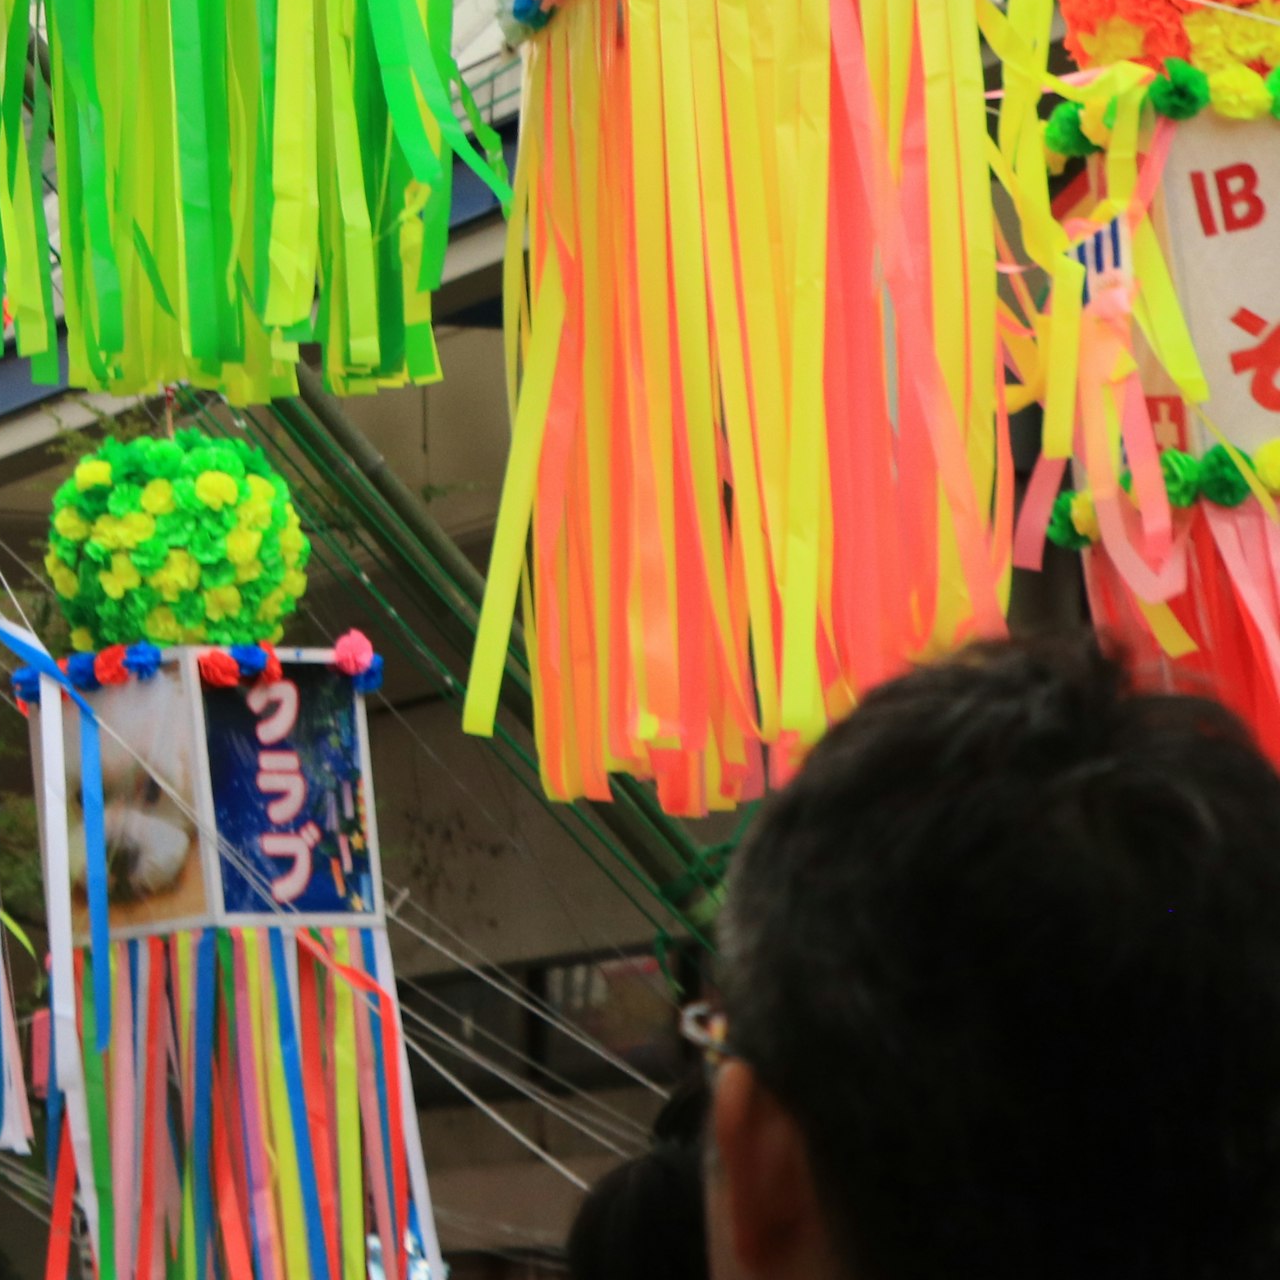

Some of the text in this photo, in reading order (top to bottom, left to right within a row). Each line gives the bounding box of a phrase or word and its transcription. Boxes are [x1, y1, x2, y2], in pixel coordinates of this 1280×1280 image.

[1188, 160, 1268, 238] IB
[246, 677, 322, 905] クラブ
